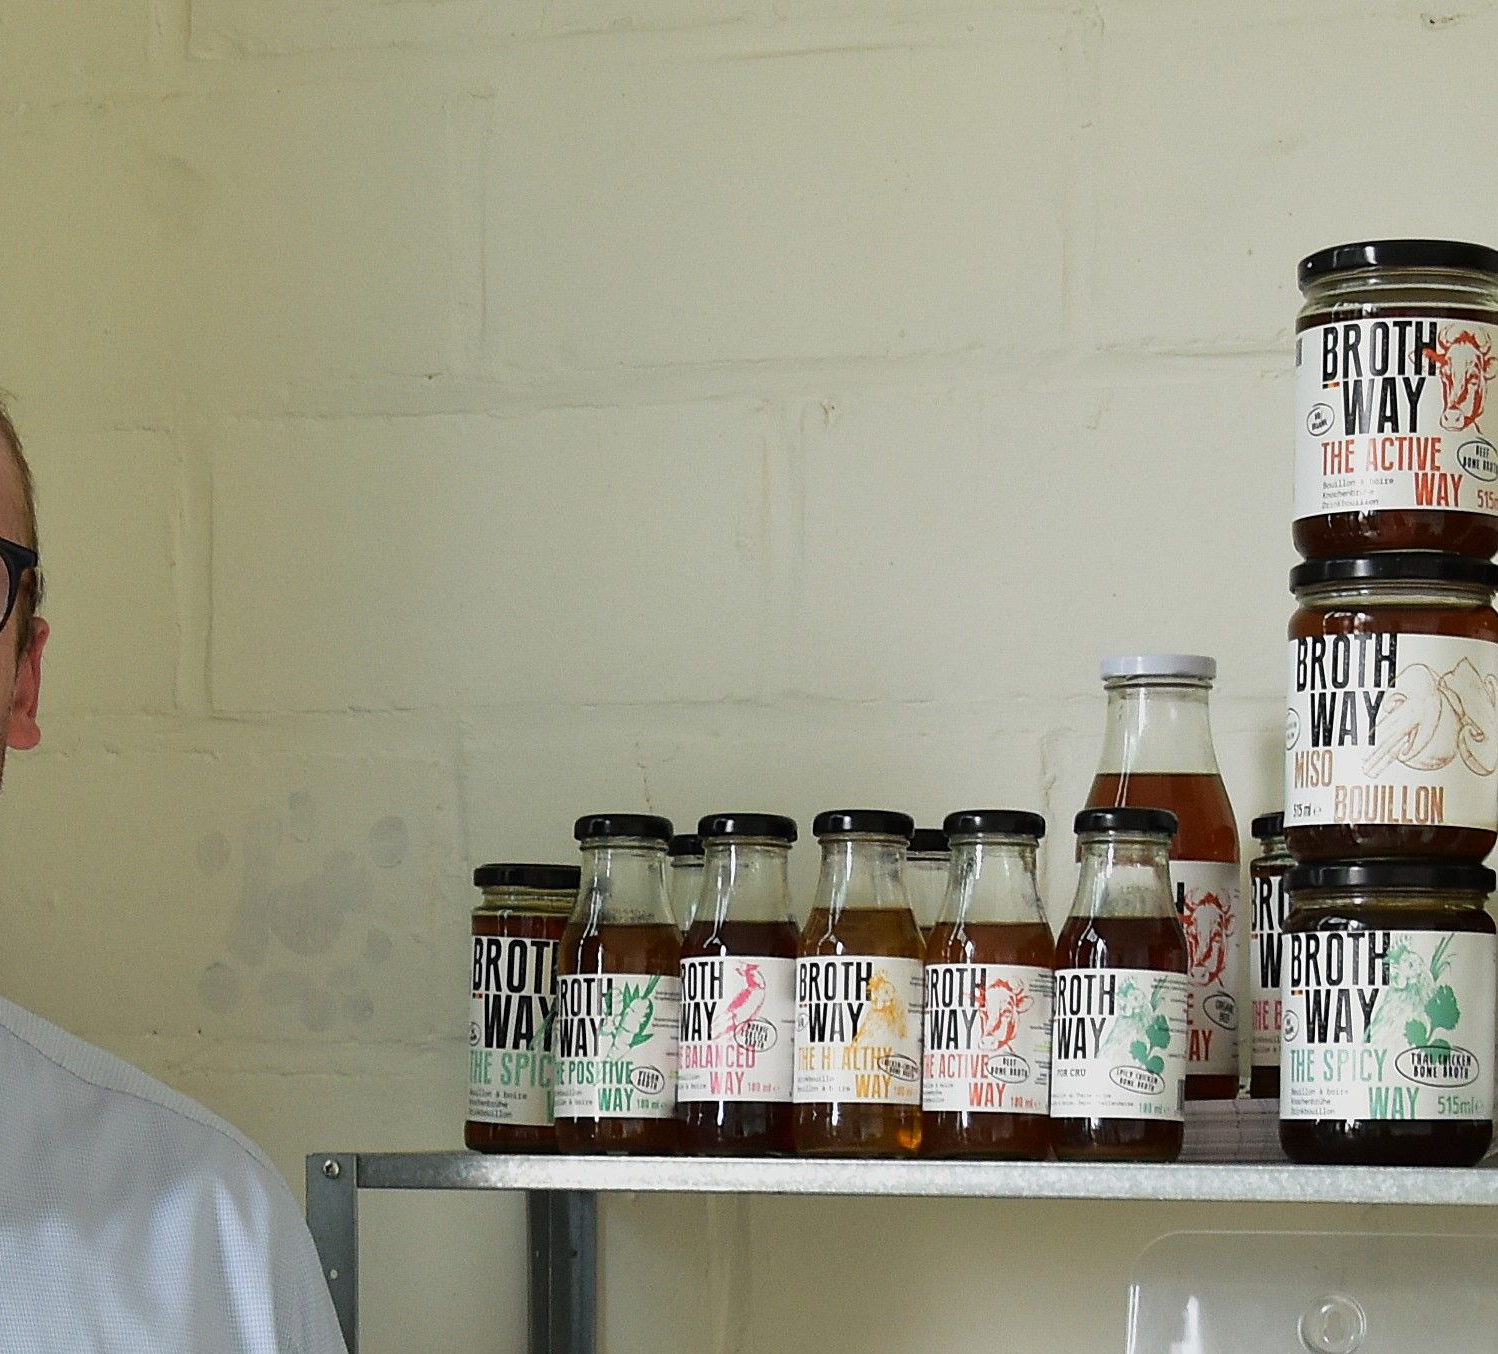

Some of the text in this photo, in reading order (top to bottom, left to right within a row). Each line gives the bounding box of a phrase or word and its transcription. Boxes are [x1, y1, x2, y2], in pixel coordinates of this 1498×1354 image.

[1322, 320, 1438, 382] BROTH
[1342, 376, 1427, 436] WAY
[1321, 436, 1442, 476] THE ACTIVE
[1414, 472, 1464, 508] WAY
[1296, 632, 1398, 692] BROTH
[1310, 690, 1386, 747] WAY
[1294, 749, 1333, 789] MISO
[1334, 785, 1445, 824] BOUILLON
[1291, 932, 1390, 987] BROTH
[800, 961, 873, 1002] BROTH
[809, 1002, 863, 1043] WAY
[929, 1009, 979, 1051] WAY
[1304, 988, 1379, 1044] WAY
[560, 1017, 605, 1058] WAY
[1057, 1017, 1107, 1060] WAY
[469, 1051, 492, 1086] THE
[568, 1061, 634, 1087] POSTIVE
[685, 1044, 756, 1069] BALANCED
[821, 1046, 893, 1071] HALTHY
[938, 1053, 989, 1079] ACTIVE
[1069, 1068, 1087, 1077] CRU
[1291, 1049, 1388, 1082] THE SPICY
[1413, 1065, 1469, 1079] BONE BROTH
[598, 1087, 635, 1112] WAY
[709, 1071, 745, 1095] WAY
[855, 1074, 892, 1099] WAY
[968, 1082, 1007, 1108] WAY
[1368, 1086, 1420, 1120] WAY
